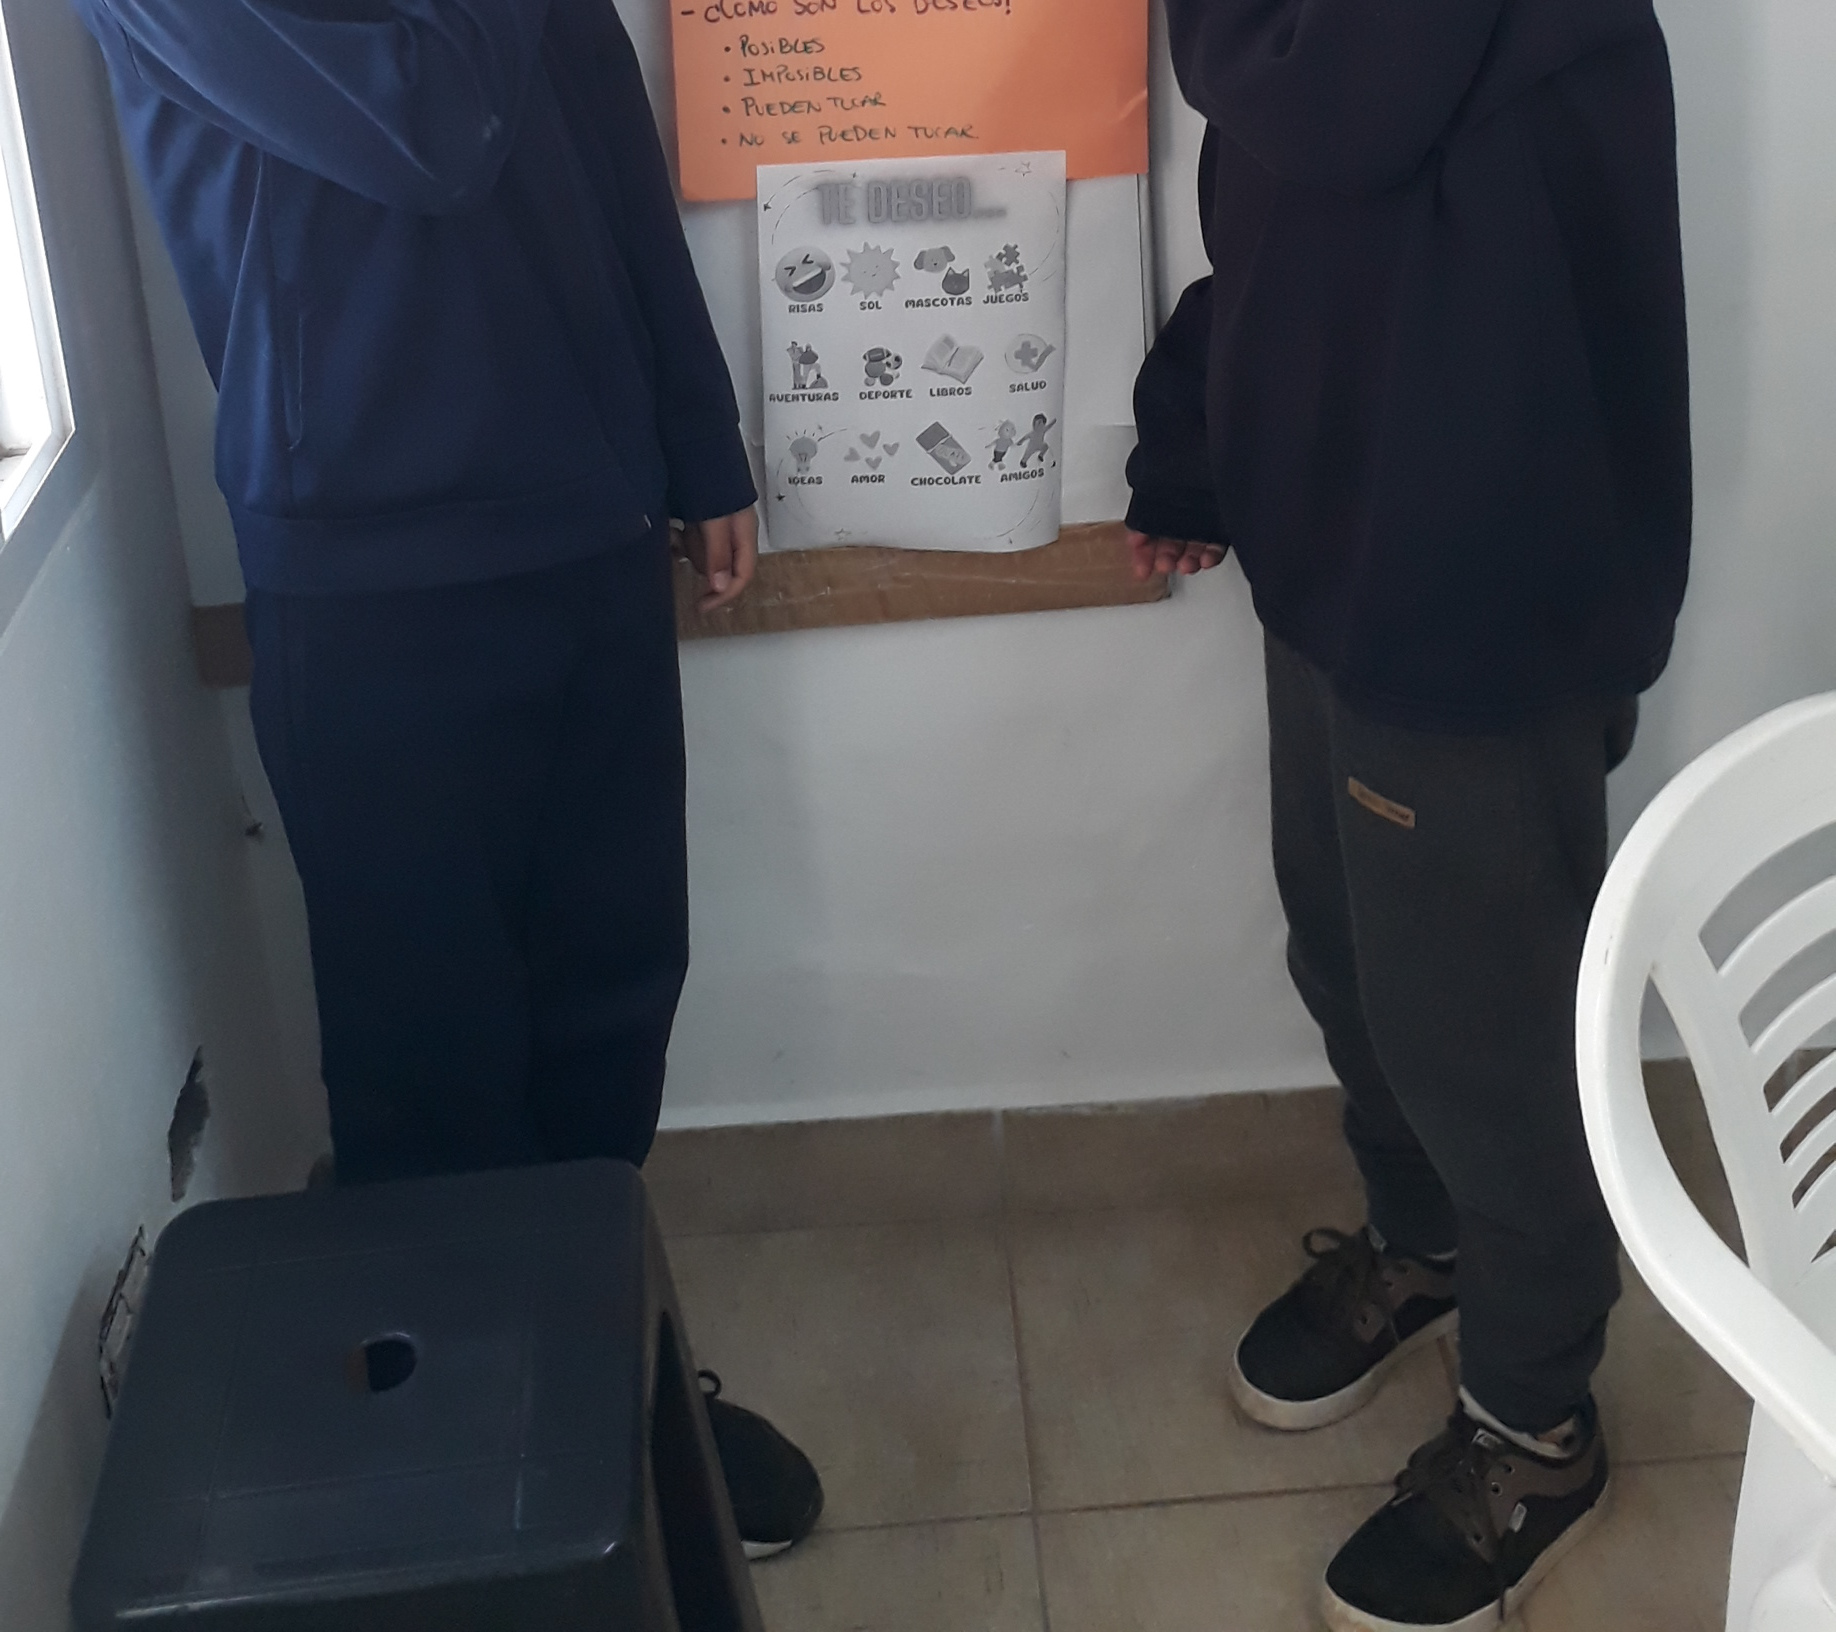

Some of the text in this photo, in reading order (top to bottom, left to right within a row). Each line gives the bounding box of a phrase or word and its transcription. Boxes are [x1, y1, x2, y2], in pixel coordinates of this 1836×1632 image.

[741, 96, 822, 116] PUEDEN
[782, 129, 803, 145] SE
[818, 125, 897, 145] PUEDEN
[817, 182, 856, 225] TE
[904, 296, 973, 308] MASCOTAS
[982, 292, 1029, 304] JUEGOS
[788, 302, 824, 313] RISAS
[859, 300, 882, 311] SOL
[929, 386, 972, 398] LIBROS
[1009, 380, 1047, 393] SALUD
[769, 391, 839, 402] AVENTURAS
[859, 389, 913, 400] DEPORTE
[788, 475, 823, 485] IDEAS
[851, 474, 885, 484] AMOR
[911, 475, 981, 486] CHOCOLATE
[1000, 468, 1044, 483] AMIGOS
